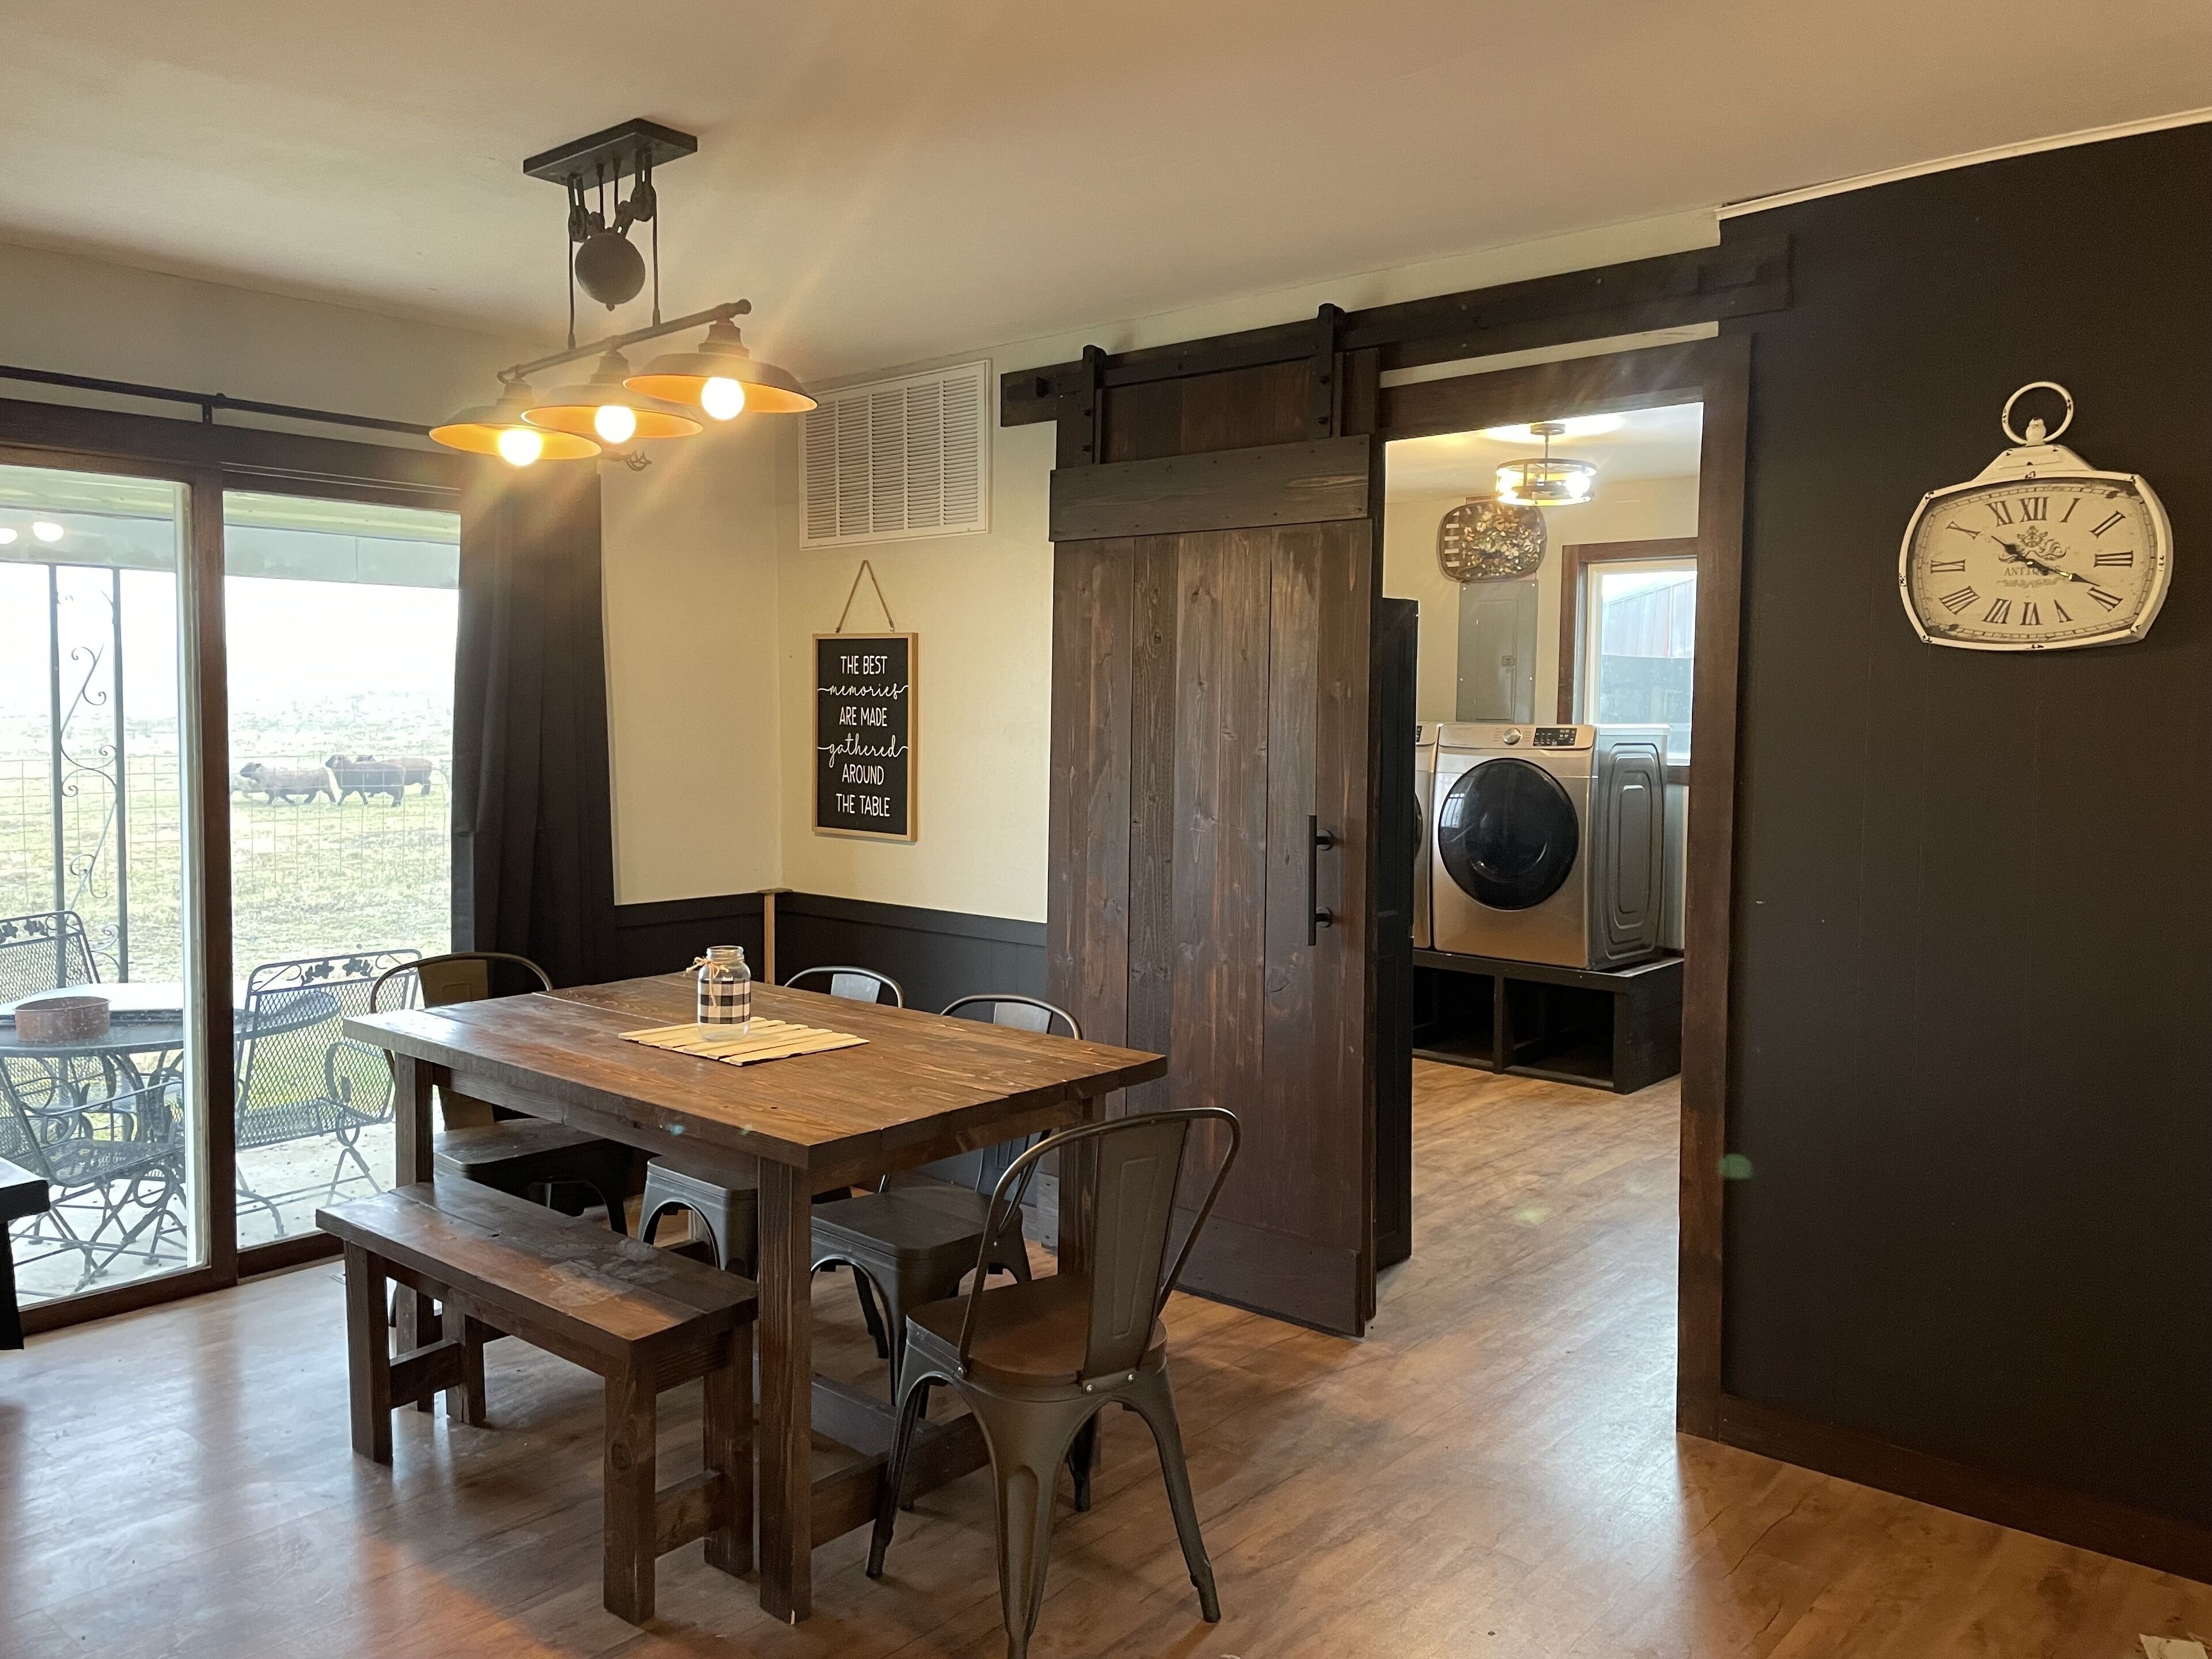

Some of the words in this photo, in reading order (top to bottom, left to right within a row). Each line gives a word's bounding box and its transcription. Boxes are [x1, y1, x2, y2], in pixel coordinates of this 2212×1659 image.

[1985, 500, 2014, 527] XI
[2017, 497, 2050, 523] XII
[1945, 520, 1982, 540] X
[2089, 510, 2126, 539] II
[1930, 559, 1966, 574] IX
[2093, 550, 2133, 568] III
[840, 656, 859, 675] THE
[863, 655, 888, 675] BEST
[817, 683, 908, 700] memories
[839, 706, 857, 726] ARE
[861, 707, 888, 727] MADE
[817, 733, 908, 768] gathered
[842, 763, 884, 786] AROUND
[835, 793, 855, 814] THE
[859, 795, 891, 817] TABLE
